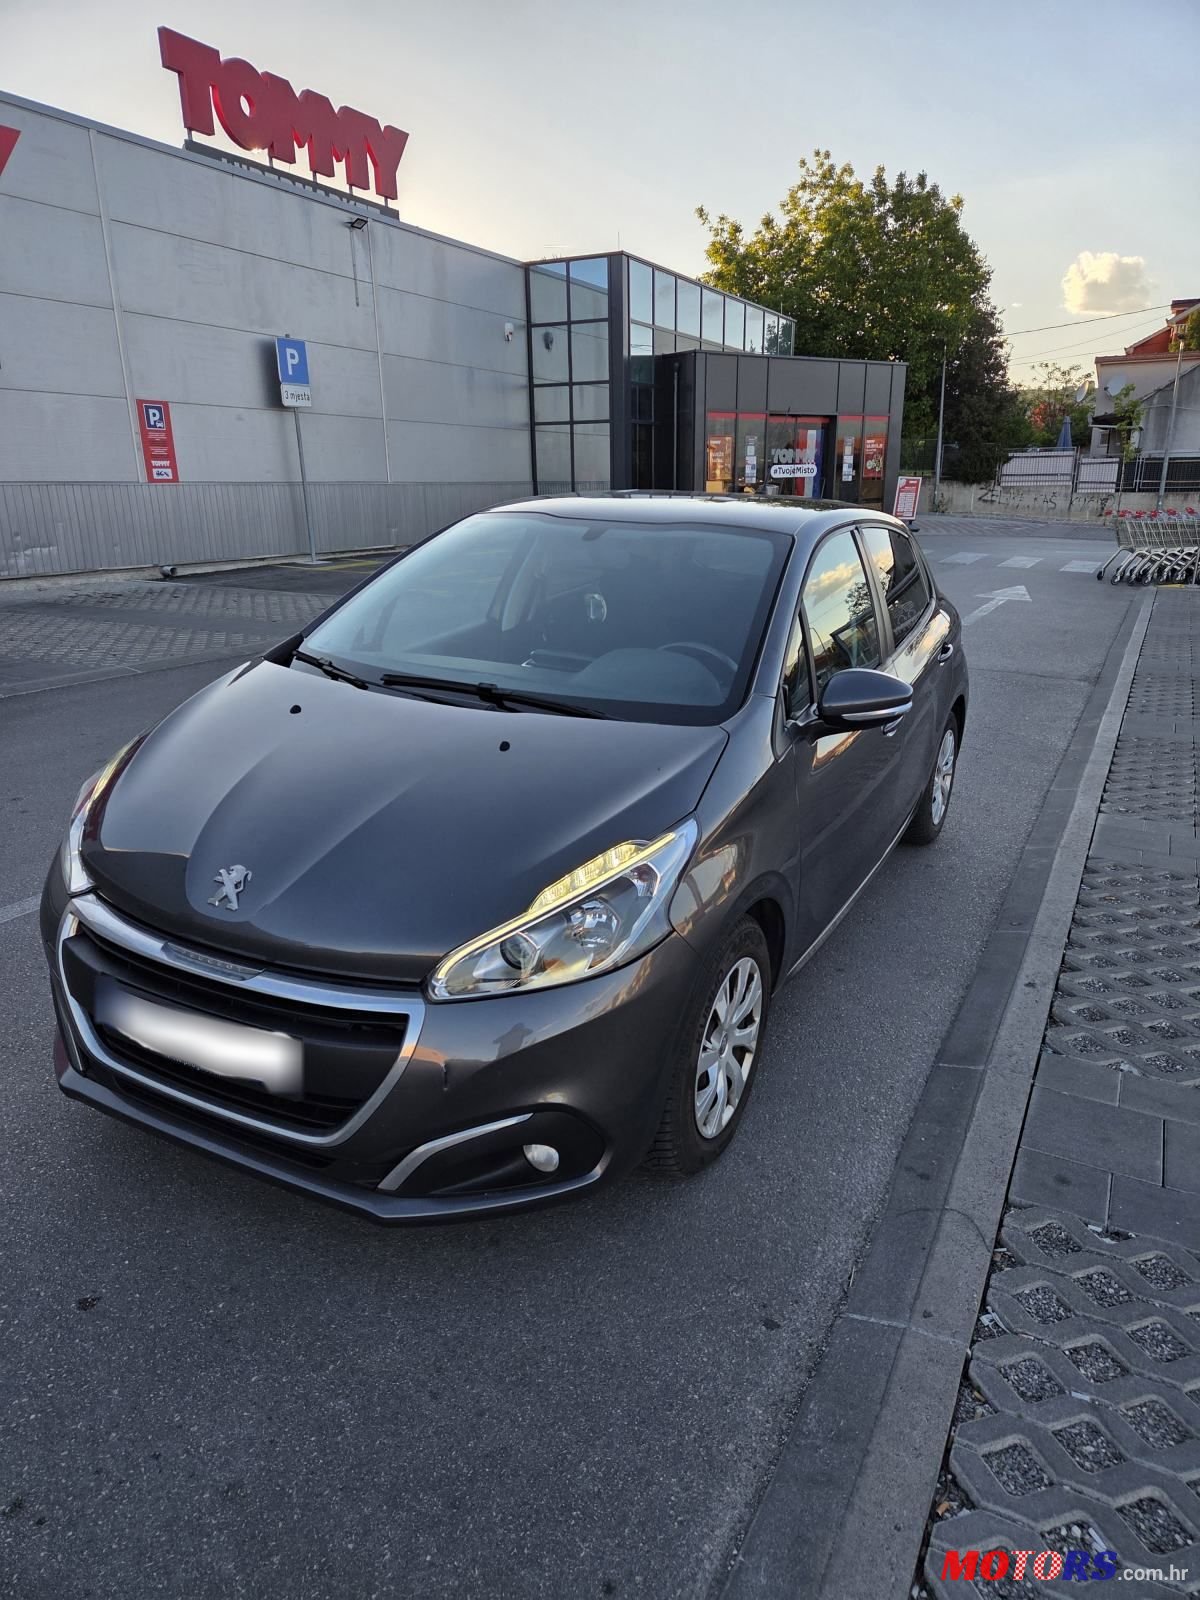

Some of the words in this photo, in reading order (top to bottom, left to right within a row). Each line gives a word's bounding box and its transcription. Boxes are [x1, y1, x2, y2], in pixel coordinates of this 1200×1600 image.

[158, 26, 409, 200] TOMMY
[286, 347, 300, 376] P
[290, 392, 311, 403] mjesta
[148, 408, 160, 426] P
[773, 466, 815, 476] #TvojeMisto
